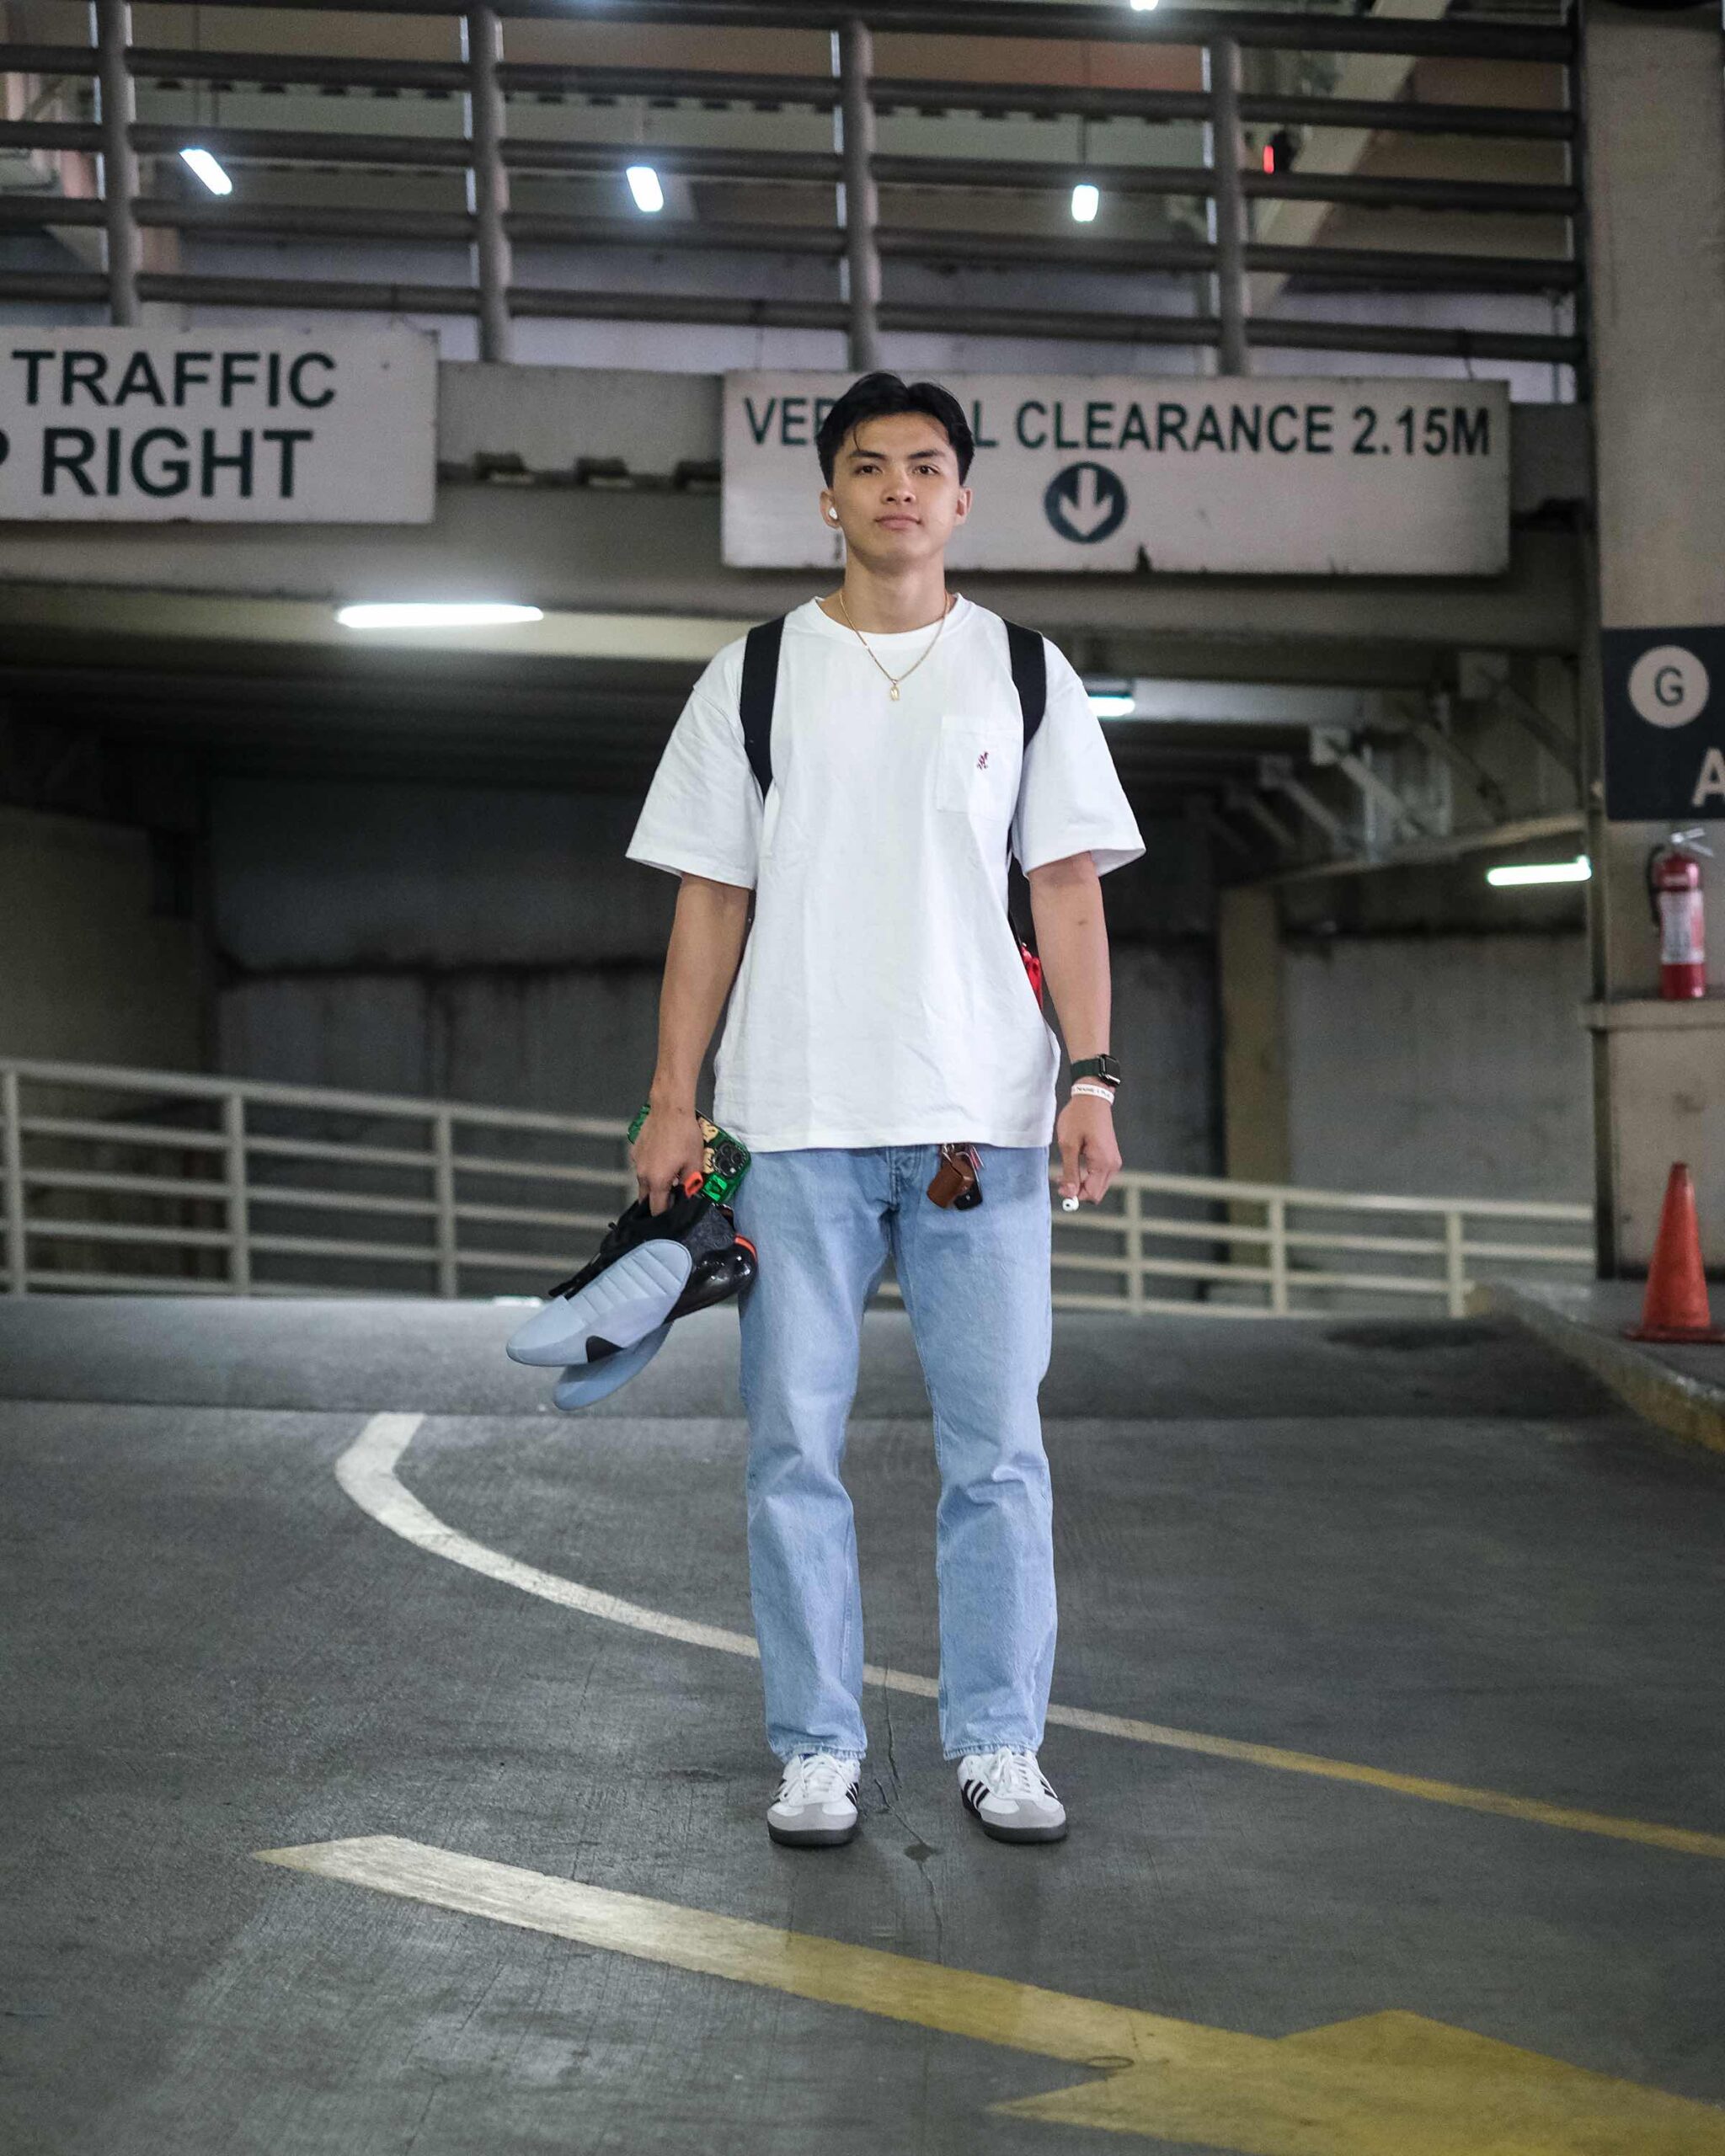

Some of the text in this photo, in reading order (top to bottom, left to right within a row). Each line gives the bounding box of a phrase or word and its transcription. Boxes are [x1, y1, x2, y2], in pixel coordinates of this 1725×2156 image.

[12, 350, 335, 408] TRAFFIC
[1017, 400, 1333, 454] CLEARANCE
[1352, 405, 1491, 456] 2.15M
[42, 427, 313, 498] RIGHT
[1654, 666, 1685, 707] G
